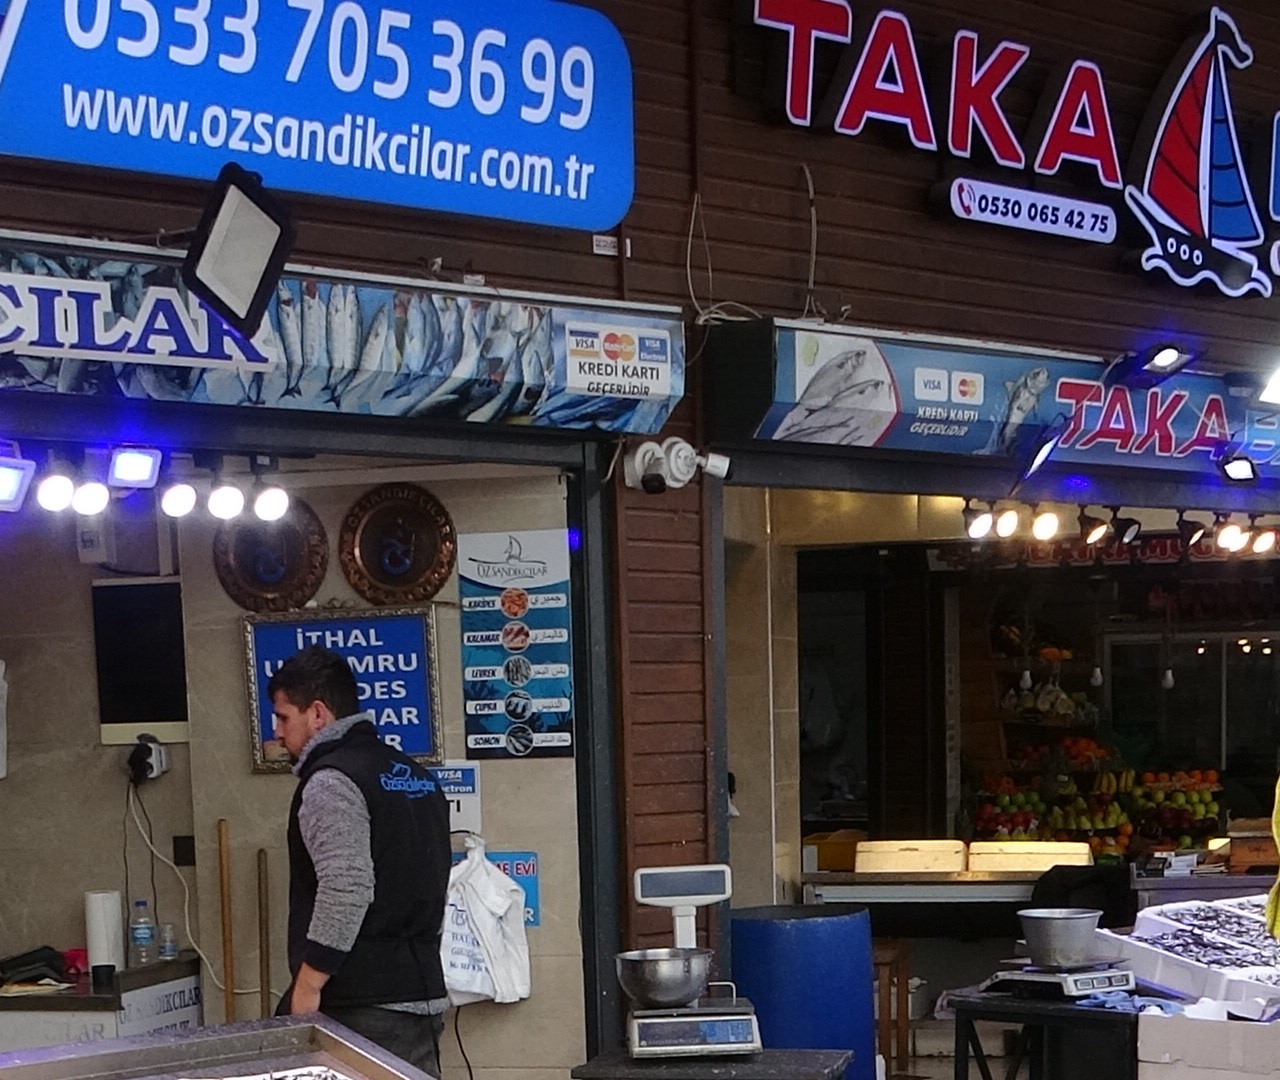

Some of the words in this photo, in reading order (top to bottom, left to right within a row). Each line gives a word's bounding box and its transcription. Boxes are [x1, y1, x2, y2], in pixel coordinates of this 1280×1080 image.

[63, 0, 260, 74] 0533
[285, 0, 411, 99] 705
[428, 19, 507, 115] 36
[520, 37, 595, 131] 99
[754, 0, 1124, 190] TAKA
[63, 83, 595, 201] www.ozsandikcilar.com.tr
[977, 193, 1022, 219] 0530
[1027, 202, 1061, 226] 065
[1064, 209, 1086, 231] 42
[1089, 213, 1110, 234] 75
[574, 337, 596, 350] VISA
[644, 338, 661, 348] VISA
[578, 360, 619, 377] KREDİ
[621, 365, 660, 381] KARTI
[586, 380, 651, 397] GEÇERLİDİR
[922, 379, 942, 391] VISA
[1055, 377, 1231, 461] TAKA
[296, 627, 384, 650] İTHAL
[436, 770, 463, 780] VISA
[441, 784, 473, 793] ctron
[514, 858, 537, 876] EVİ
